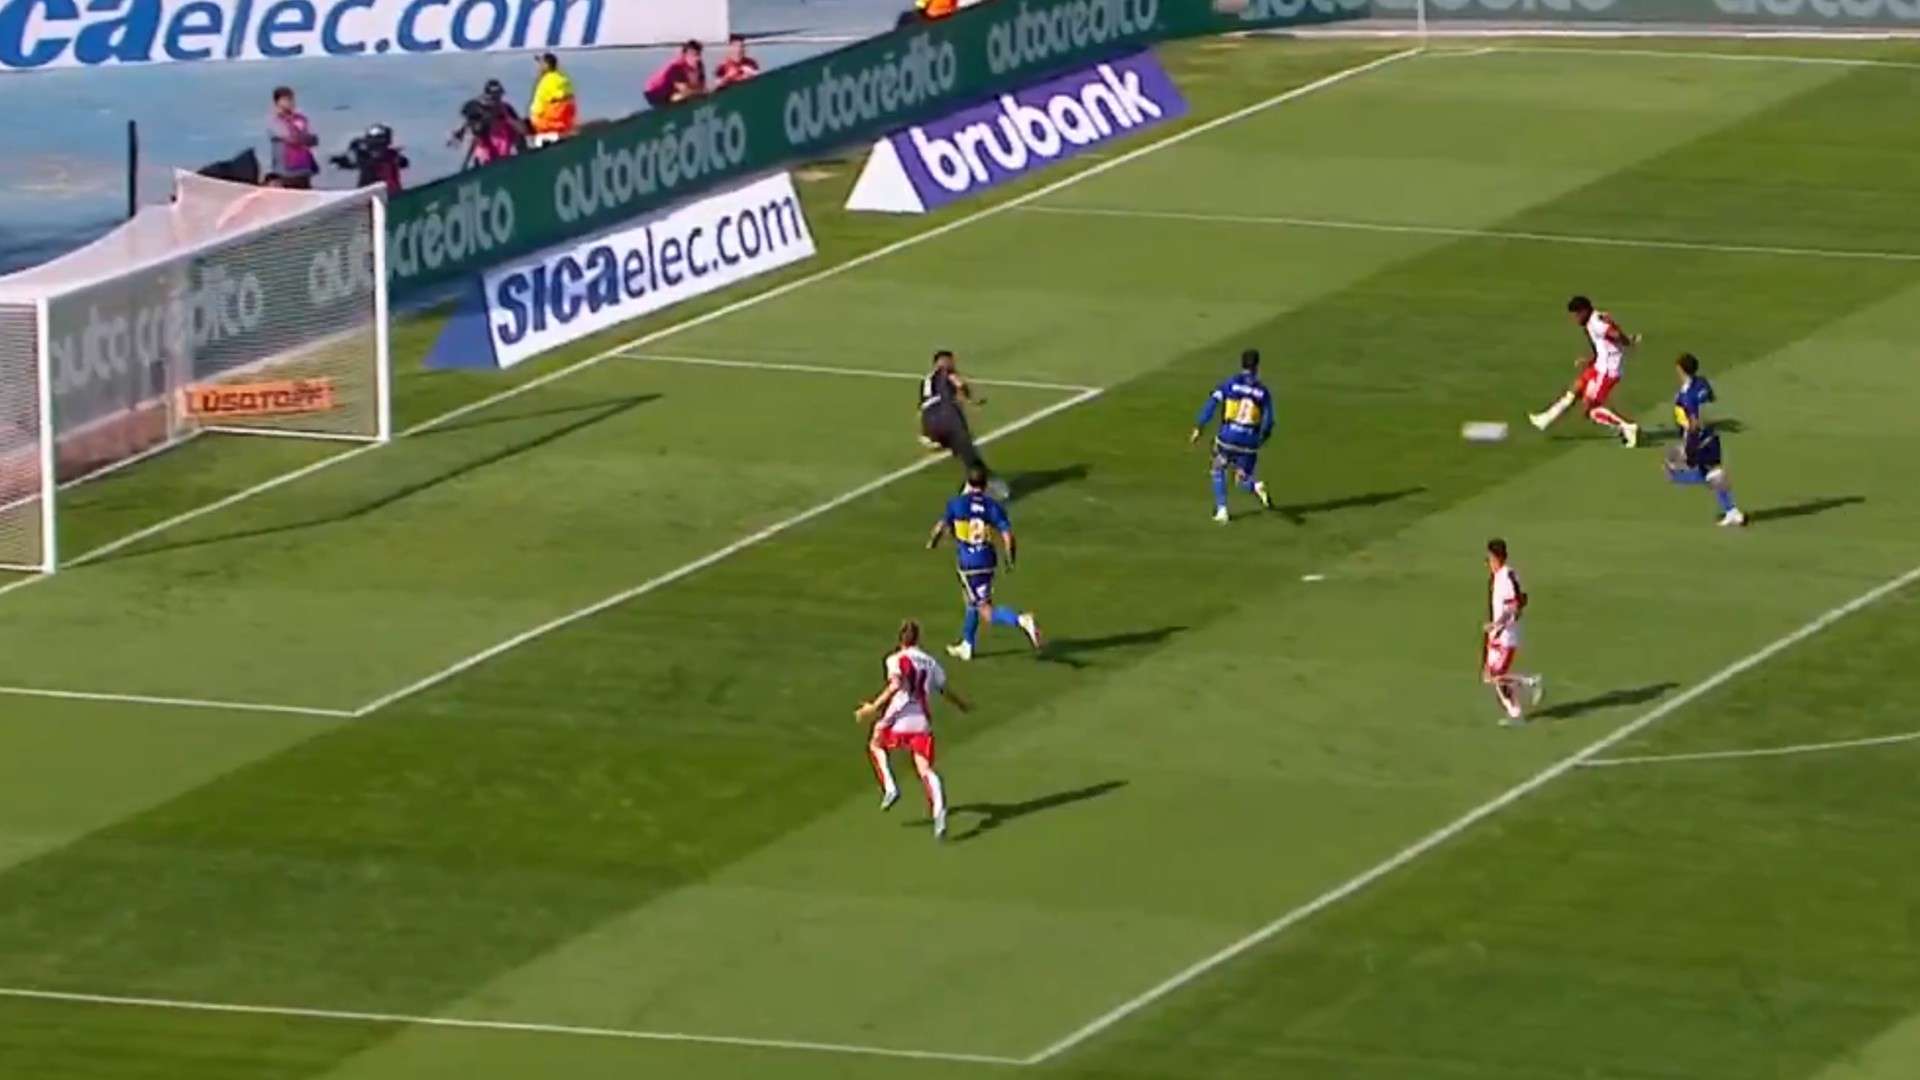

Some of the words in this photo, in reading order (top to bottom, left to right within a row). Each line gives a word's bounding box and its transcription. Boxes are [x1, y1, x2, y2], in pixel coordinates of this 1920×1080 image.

[784, 32, 957, 144] autocrédito
[909, 65, 1163, 192] brubank
[554, 108, 747, 222] autocrédito
